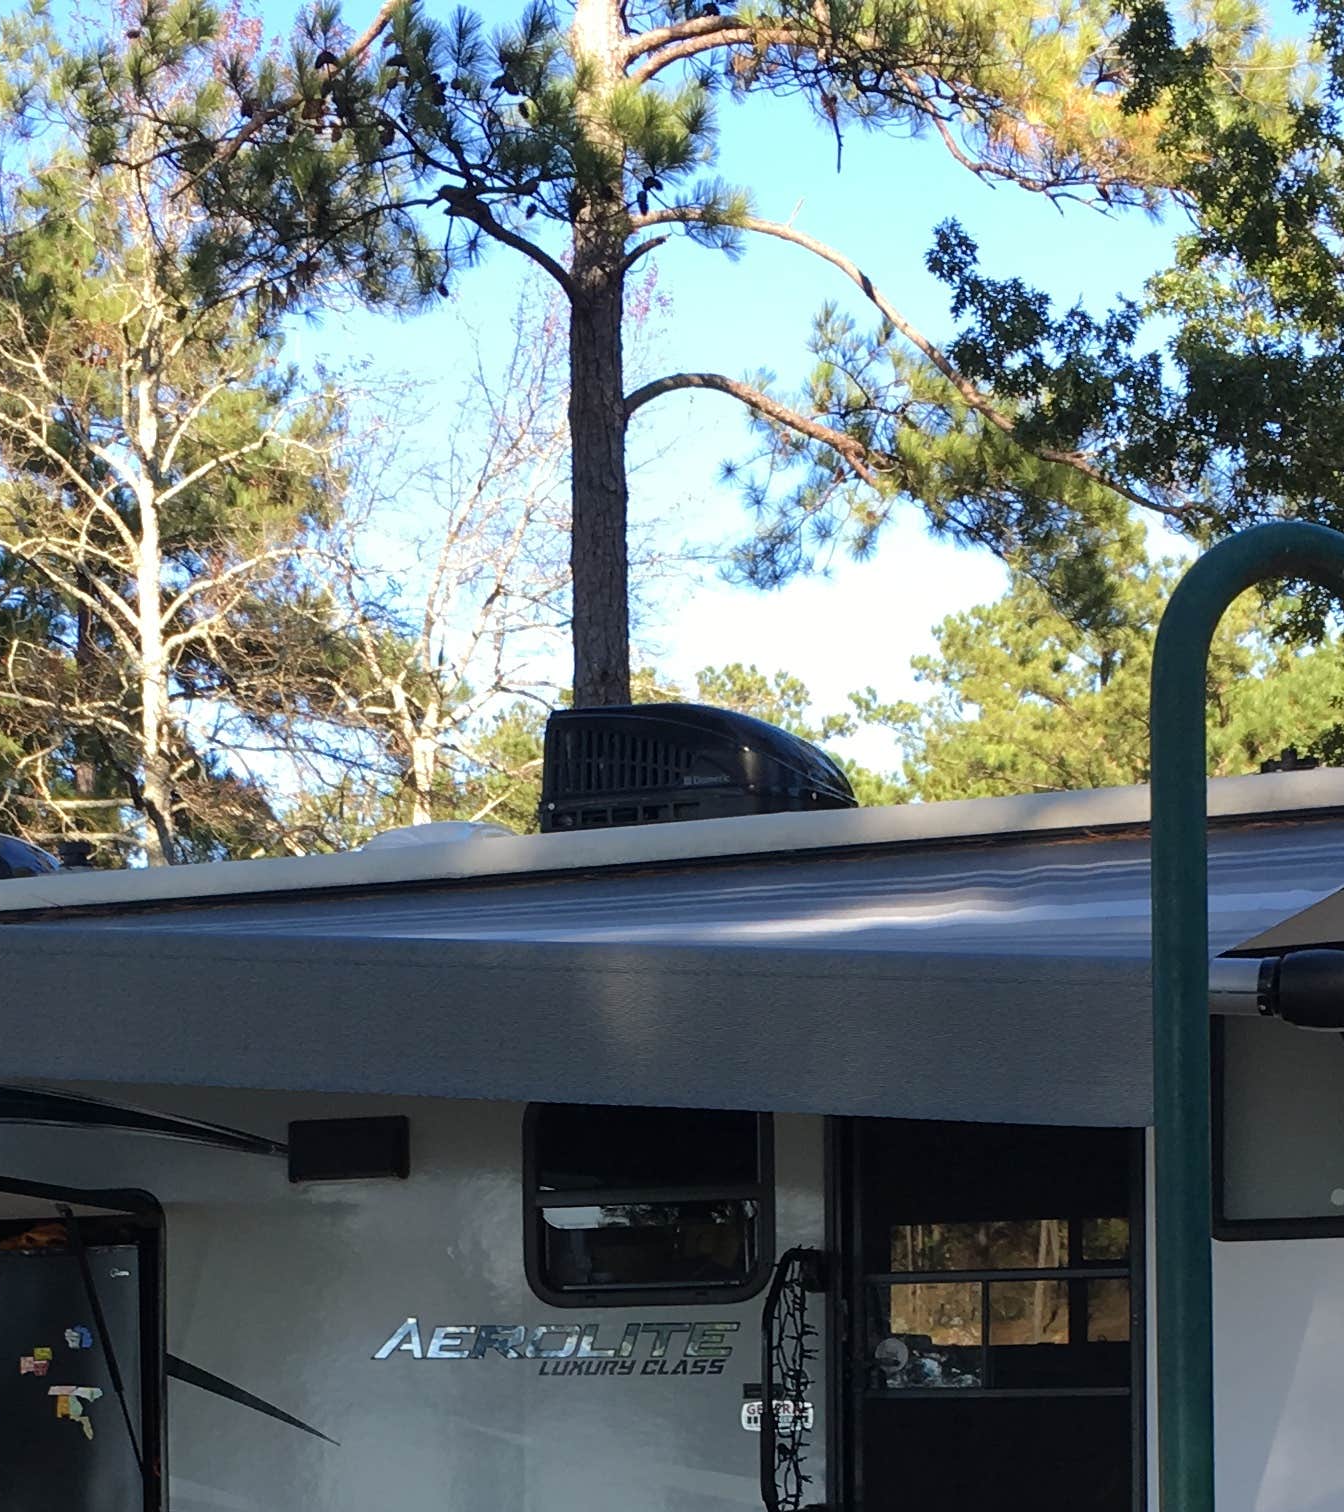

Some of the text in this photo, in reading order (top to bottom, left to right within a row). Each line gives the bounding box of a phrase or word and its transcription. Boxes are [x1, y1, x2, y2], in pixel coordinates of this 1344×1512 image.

[370, 1316, 741, 1360] AEROLITE
[538, 1358, 726, 1376] LUXURY CLASS
